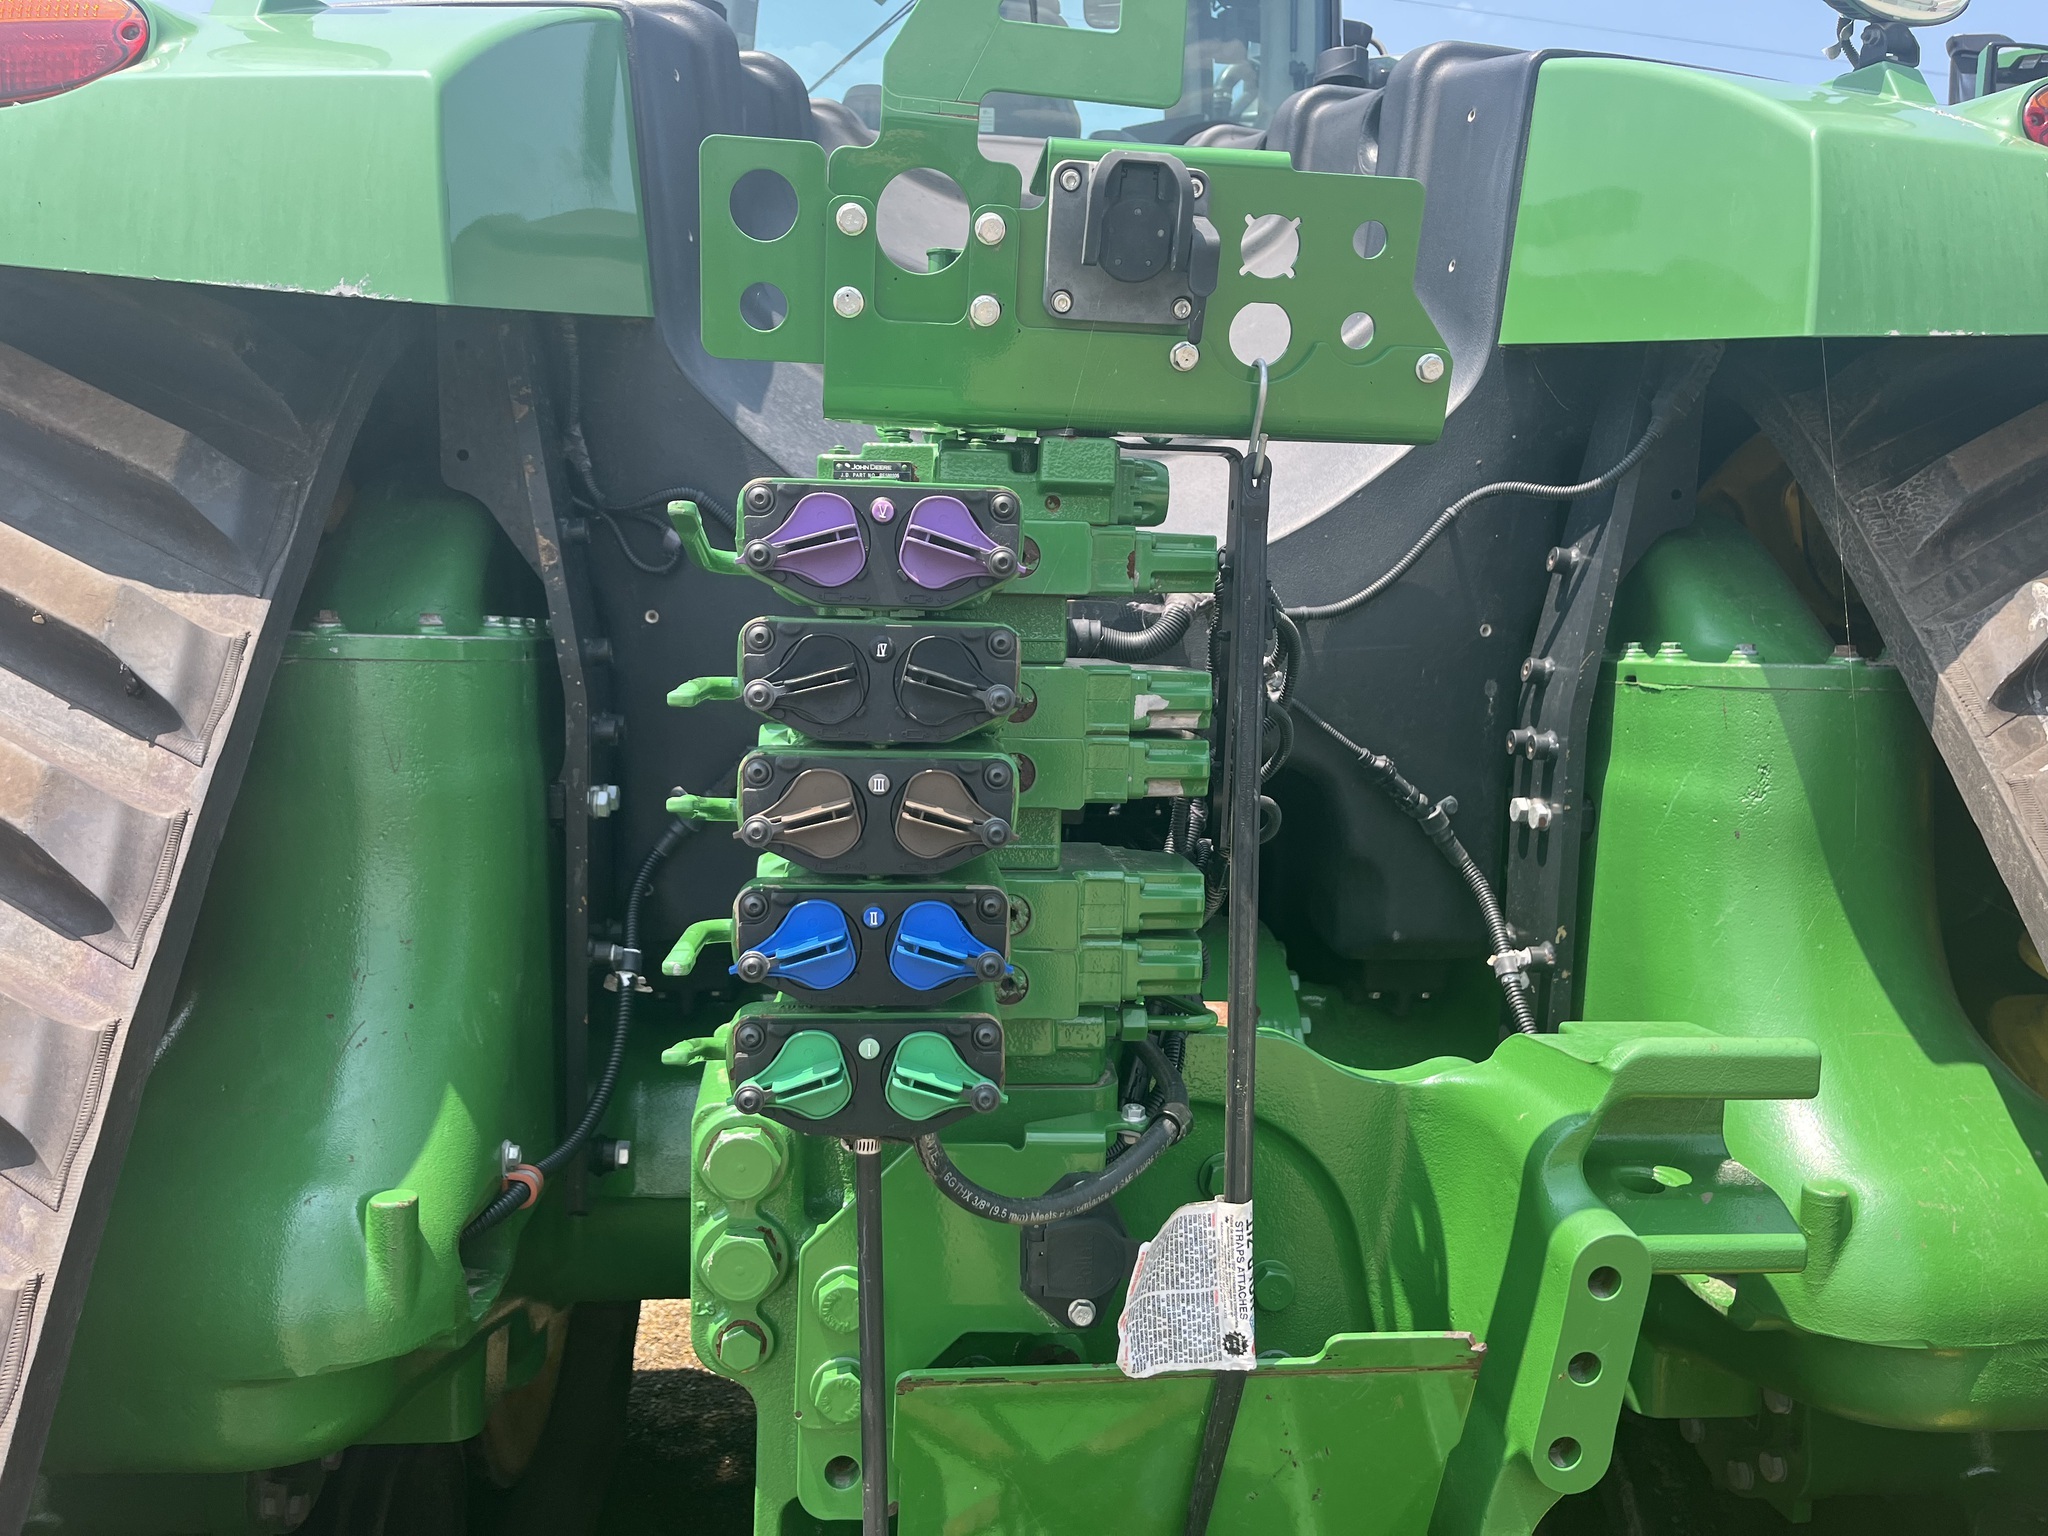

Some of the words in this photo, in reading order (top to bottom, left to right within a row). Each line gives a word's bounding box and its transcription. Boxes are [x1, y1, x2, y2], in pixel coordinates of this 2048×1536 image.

[851, 463, 870, 471] JOHN
[877, 504, 888, 519] V
[876, 643, 888, 657] IV
[873, 778, 885, 792] III
[869, 911, 878, 926] II
[971, 1195, 991, 1210] 3/8"
[988, 1205, 1008, 1219] (9.5
[1030, 1210, 1058, 1222] Meets
[1234, 1220, 1246, 1264] STRAPS
[1236, 1266, 1249, 1321] ATTACHES
